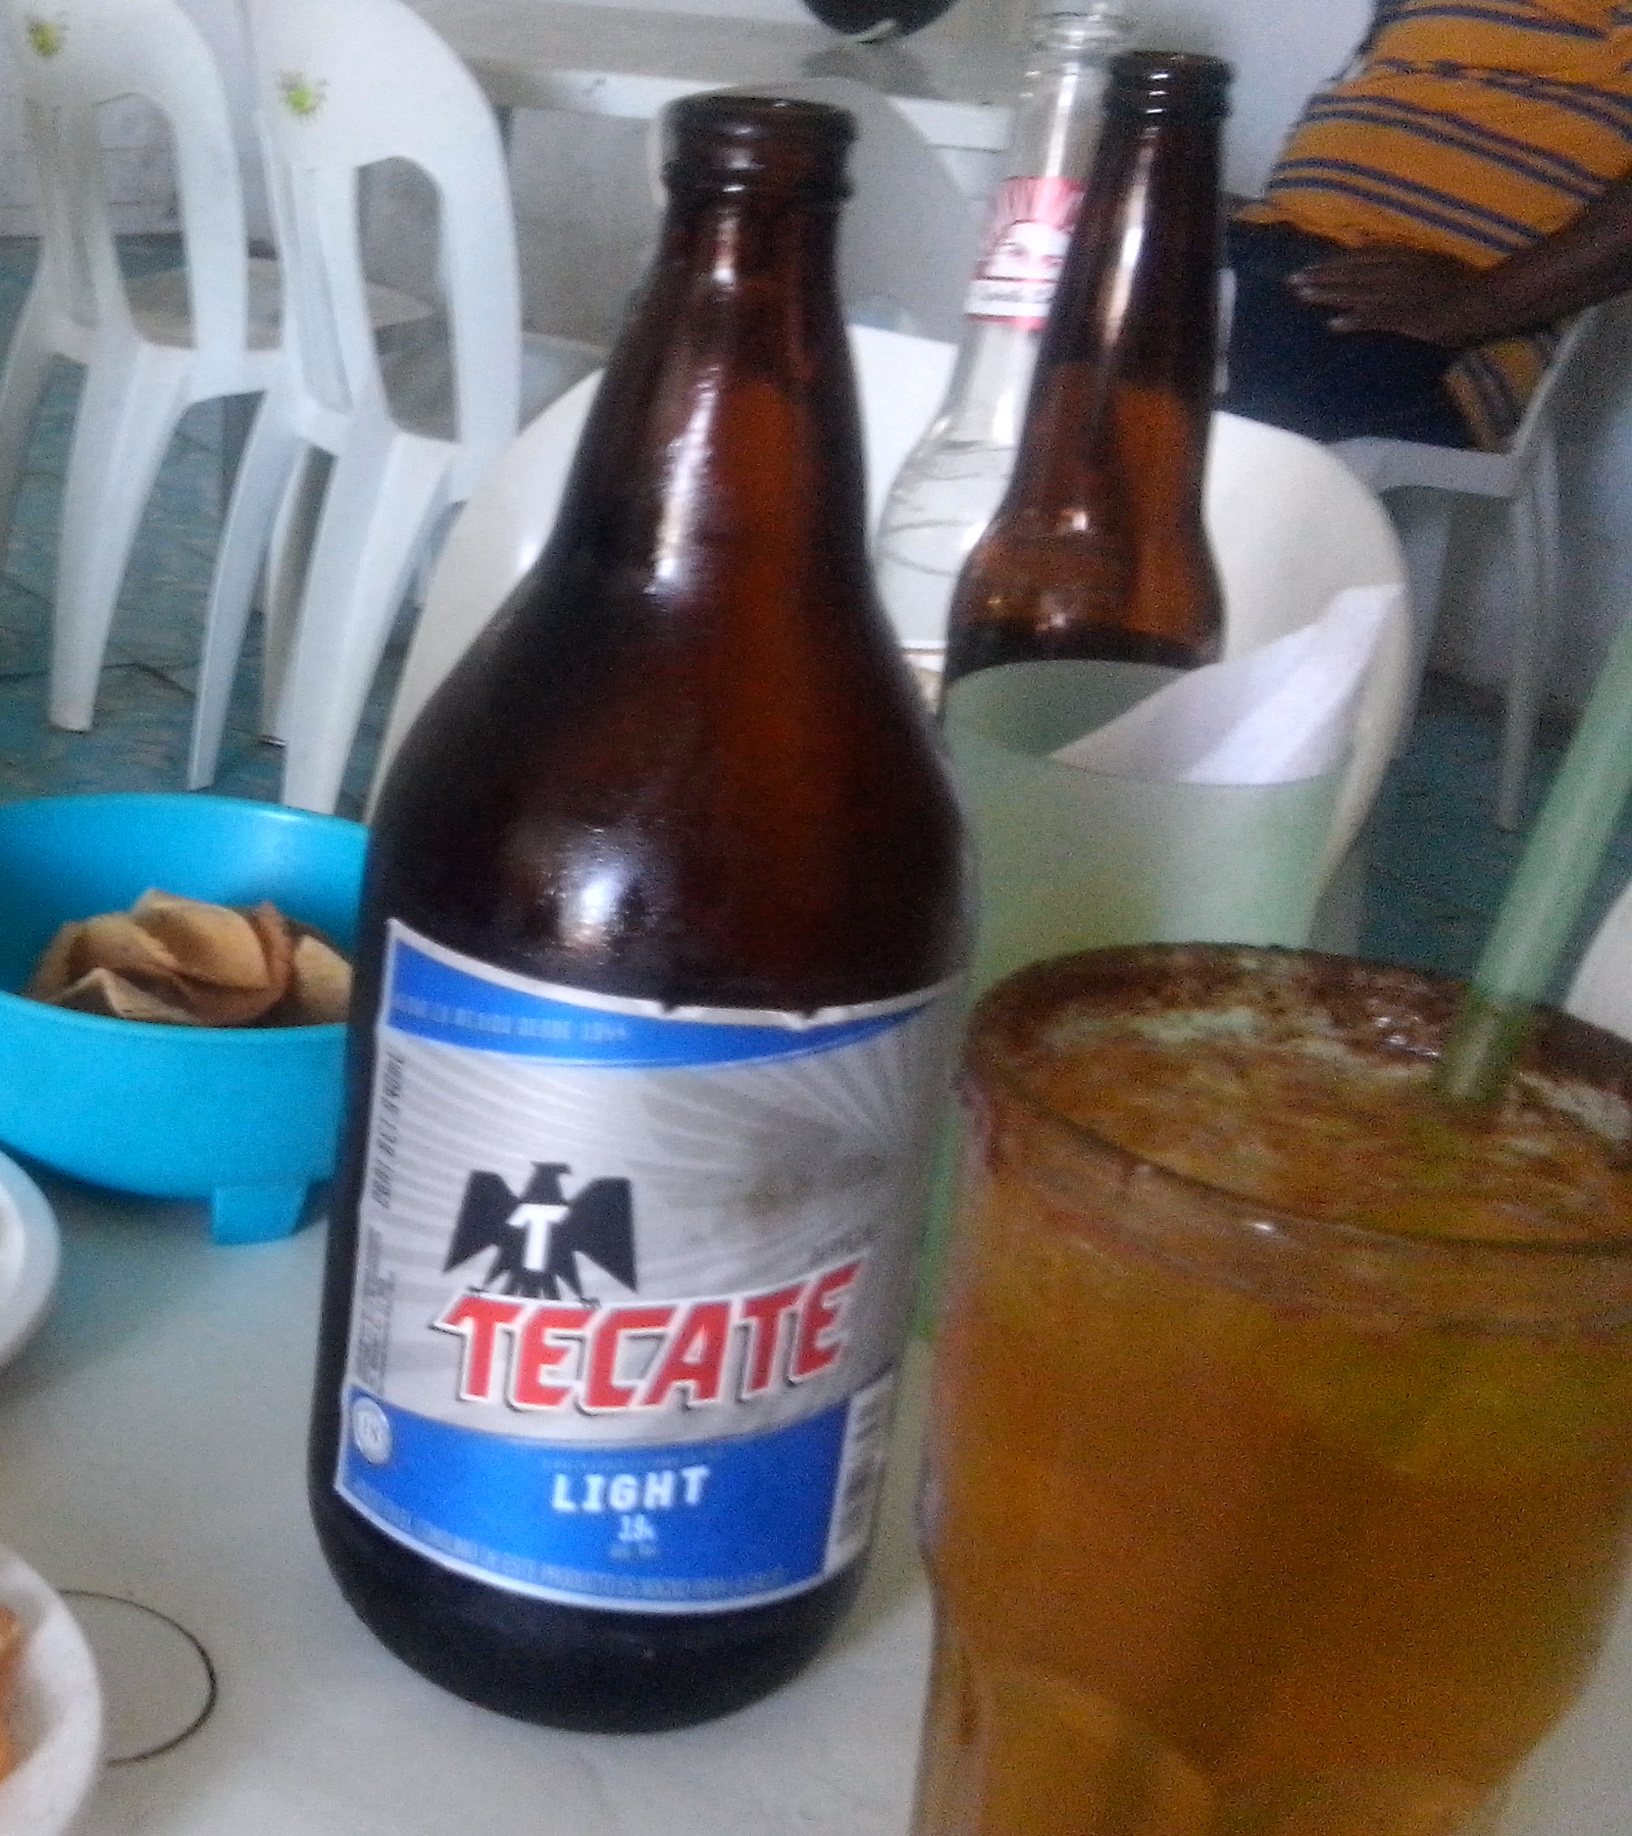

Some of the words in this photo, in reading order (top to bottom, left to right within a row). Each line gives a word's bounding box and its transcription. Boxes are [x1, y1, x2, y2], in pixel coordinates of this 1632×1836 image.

[507, 1203, 568, 1271] T
[434, 1258, 864, 1409] TECATE
[552, 1466, 709, 1511] LIGHT
